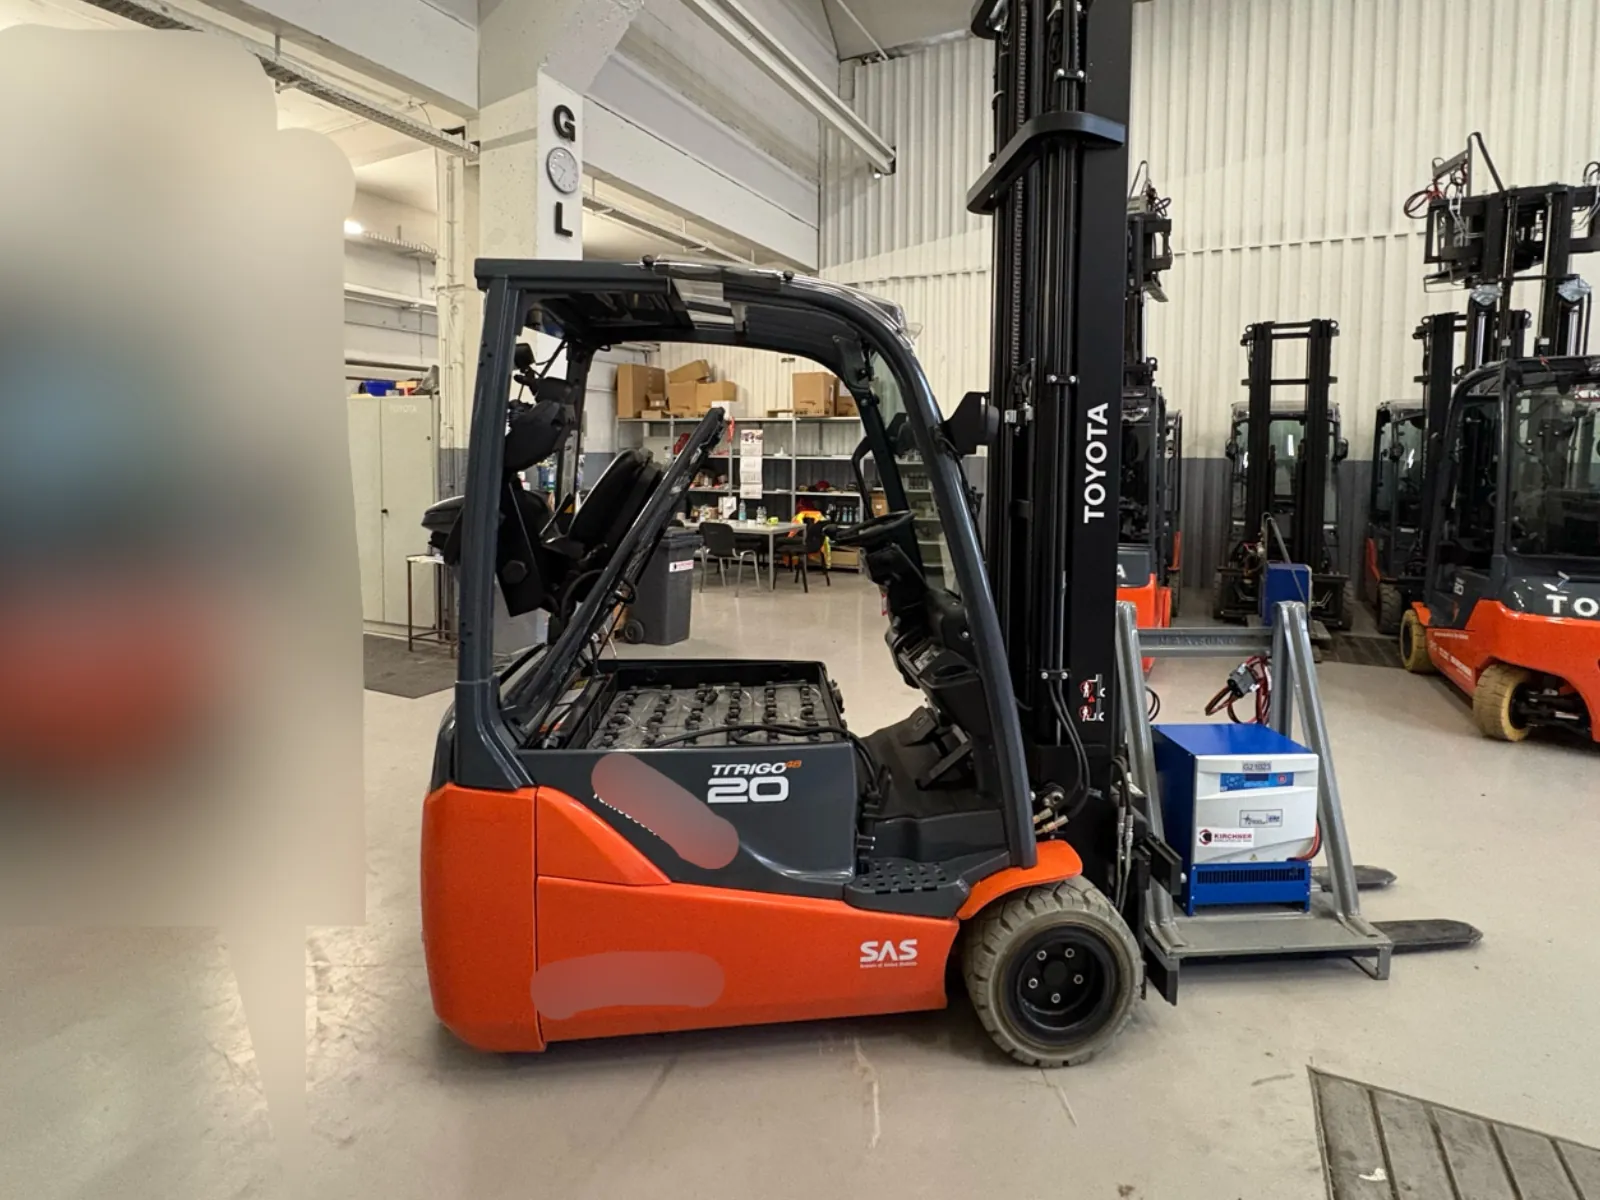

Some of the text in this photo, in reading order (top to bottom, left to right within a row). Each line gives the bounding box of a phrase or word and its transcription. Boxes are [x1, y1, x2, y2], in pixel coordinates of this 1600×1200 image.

[552, 104, 575, 142] G
[555, 201, 573, 237] L
[1083, 402, 1109, 524] TOYOTA
[1546, 593, 1600, 617] TO
[711, 762, 787, 775] TRAIGO
[707, 776, 789, 803] 20
[860, 939, 918, 962] SAS
